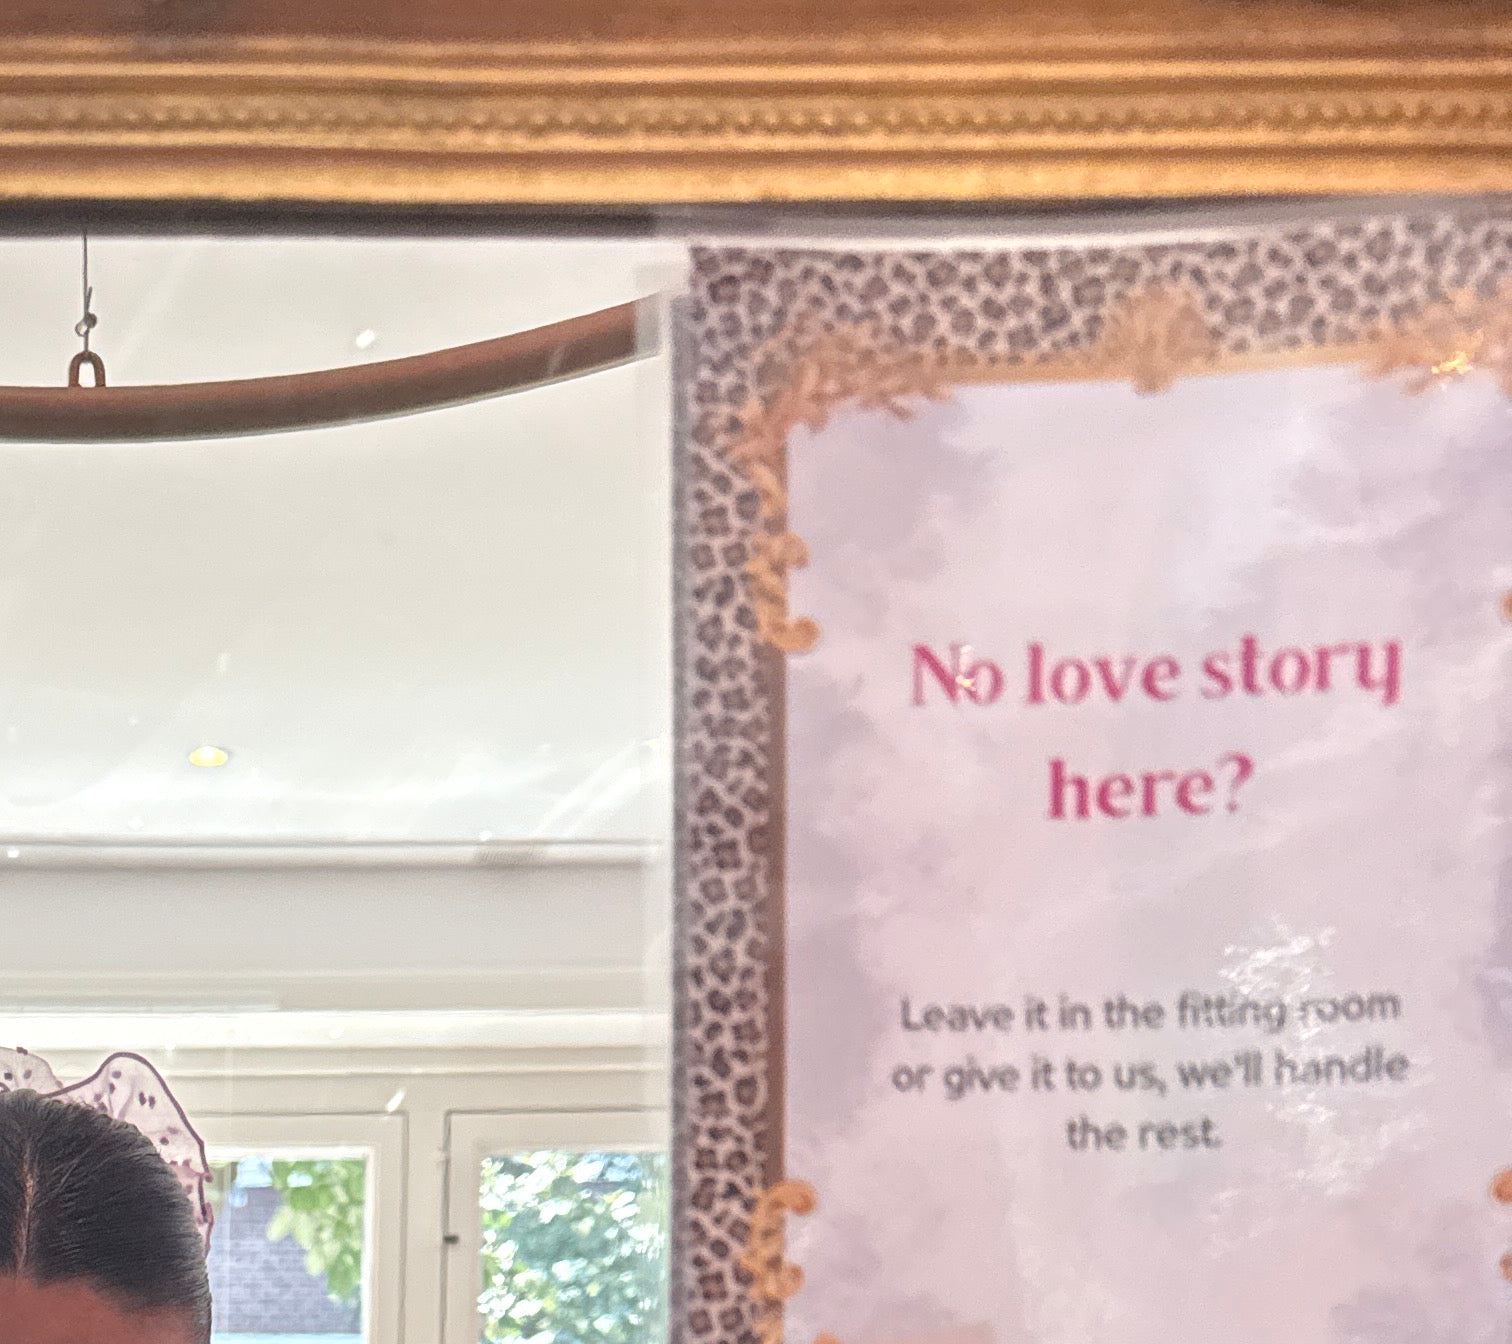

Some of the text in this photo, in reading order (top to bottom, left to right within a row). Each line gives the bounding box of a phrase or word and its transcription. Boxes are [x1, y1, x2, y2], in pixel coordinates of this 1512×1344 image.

[911, 634, 1402, 706] No love story
[1047, 752, 1255, 820] here?
[899, 991, 1401, 1035] Leave it in the fitting room
[891, 1045, 1411, 1101] or give it to us, we'll handle
[1065, 1115, 1129, 1151] the
